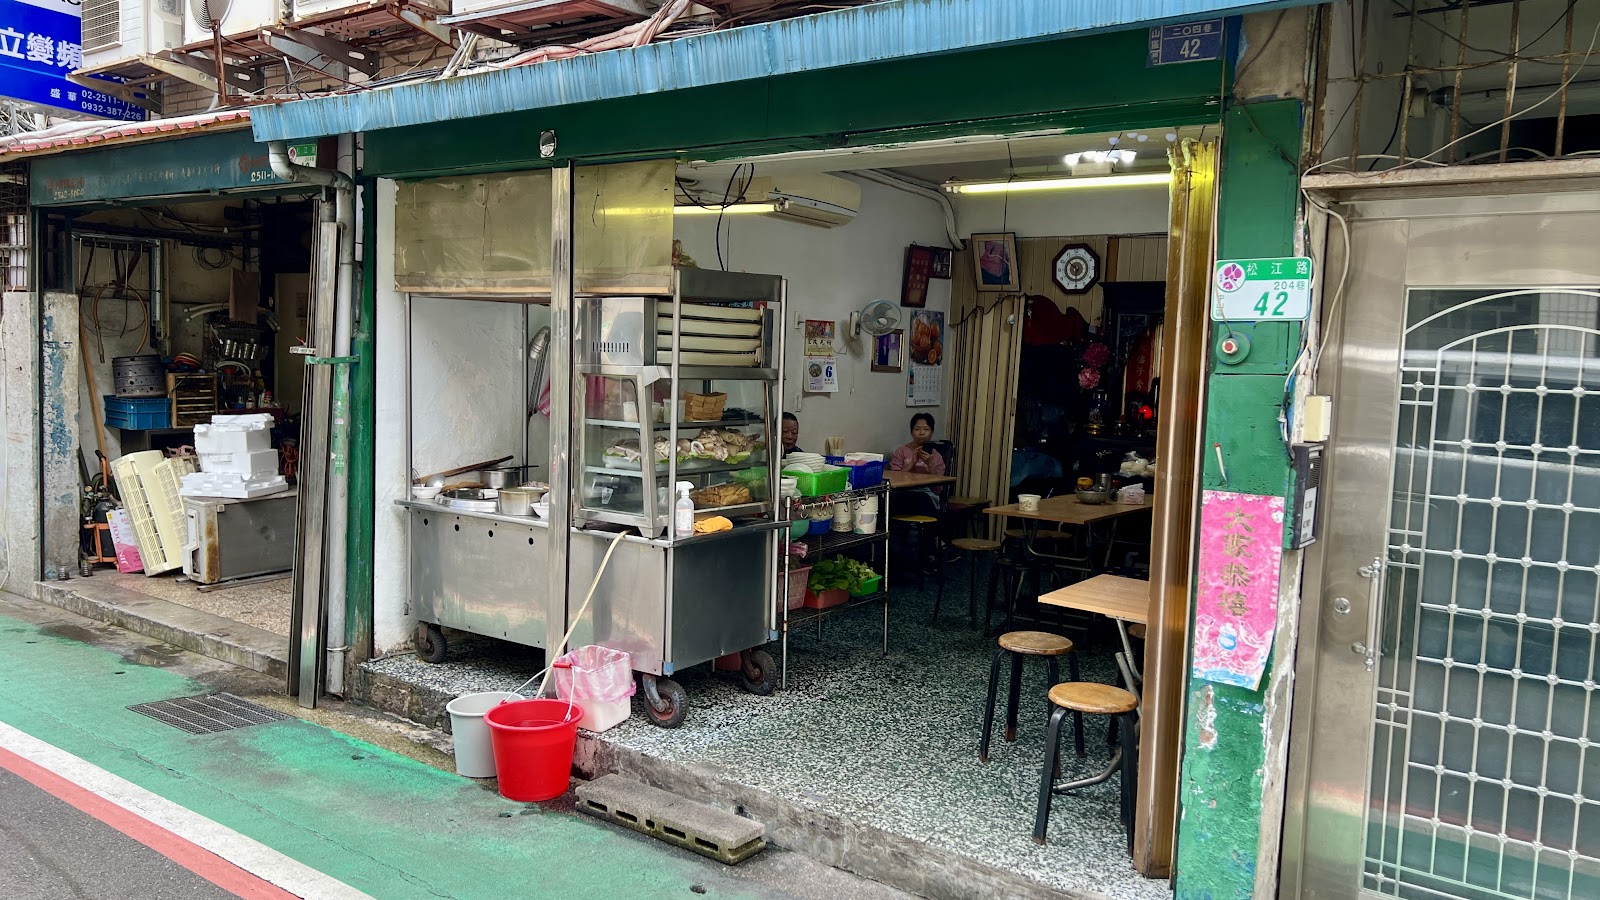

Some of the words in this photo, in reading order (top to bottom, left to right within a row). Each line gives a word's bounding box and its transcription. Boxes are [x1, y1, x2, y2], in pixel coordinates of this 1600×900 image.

[1180, 38, 1201, 58] 42
[81, 101, 142, 120] 0932-387-226
[1246, 261, 1308, 276] 松江路
[1273, 280, 1306, 291] 204巷
[1253, 291, 1289, 316] 42
[825, 365, 833, 378] 6
